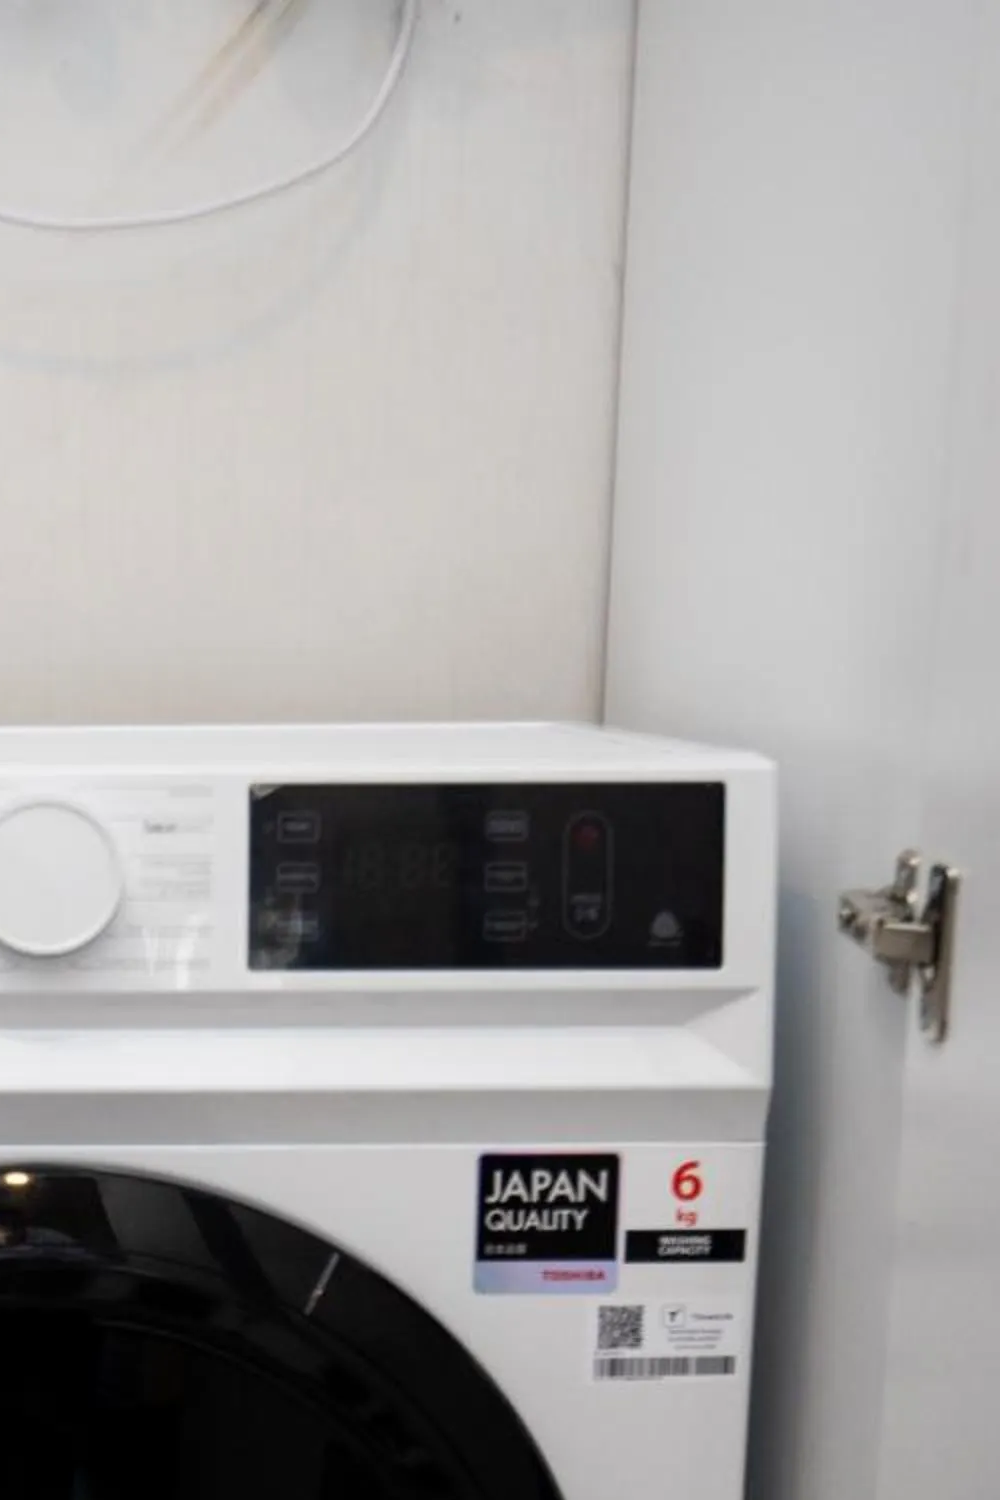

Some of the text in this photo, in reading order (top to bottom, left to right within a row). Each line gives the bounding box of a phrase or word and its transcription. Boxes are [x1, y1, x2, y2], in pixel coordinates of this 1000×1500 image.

[485, 1169, 609, 1204] JAPAN
[671, 1160, 702, 1203] 6
[484, 1209, 589, 1232] QUALITY
[676, 1209, 698, 1227] kg
